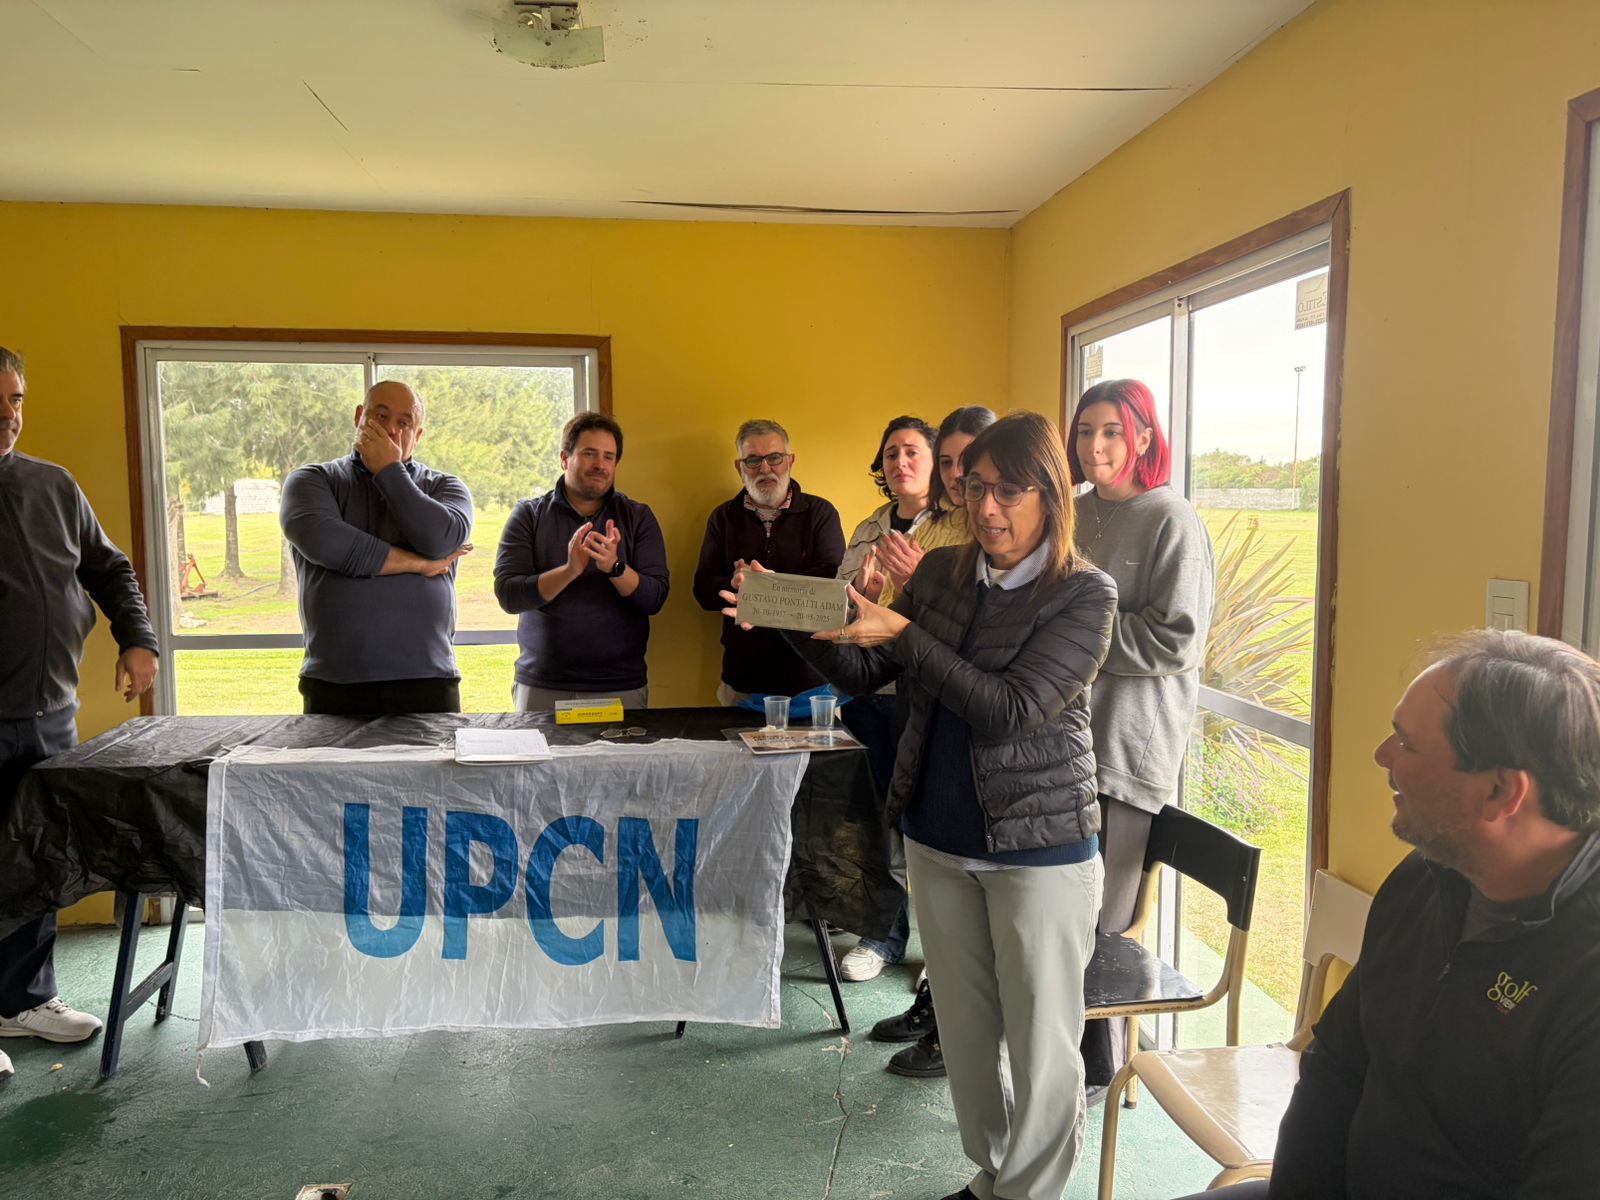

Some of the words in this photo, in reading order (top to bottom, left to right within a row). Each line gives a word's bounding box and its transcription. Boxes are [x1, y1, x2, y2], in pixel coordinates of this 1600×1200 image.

[772, 583, 781, 592] En
[741, 592, 778, 605] GUSTAVO
[779, 597, 819, 609] PONTALTI
[820, 601, 844, 612] ADAM
[343, 802, 699, 966] UPCN
[1487, 971, 1539, 1004] golf
